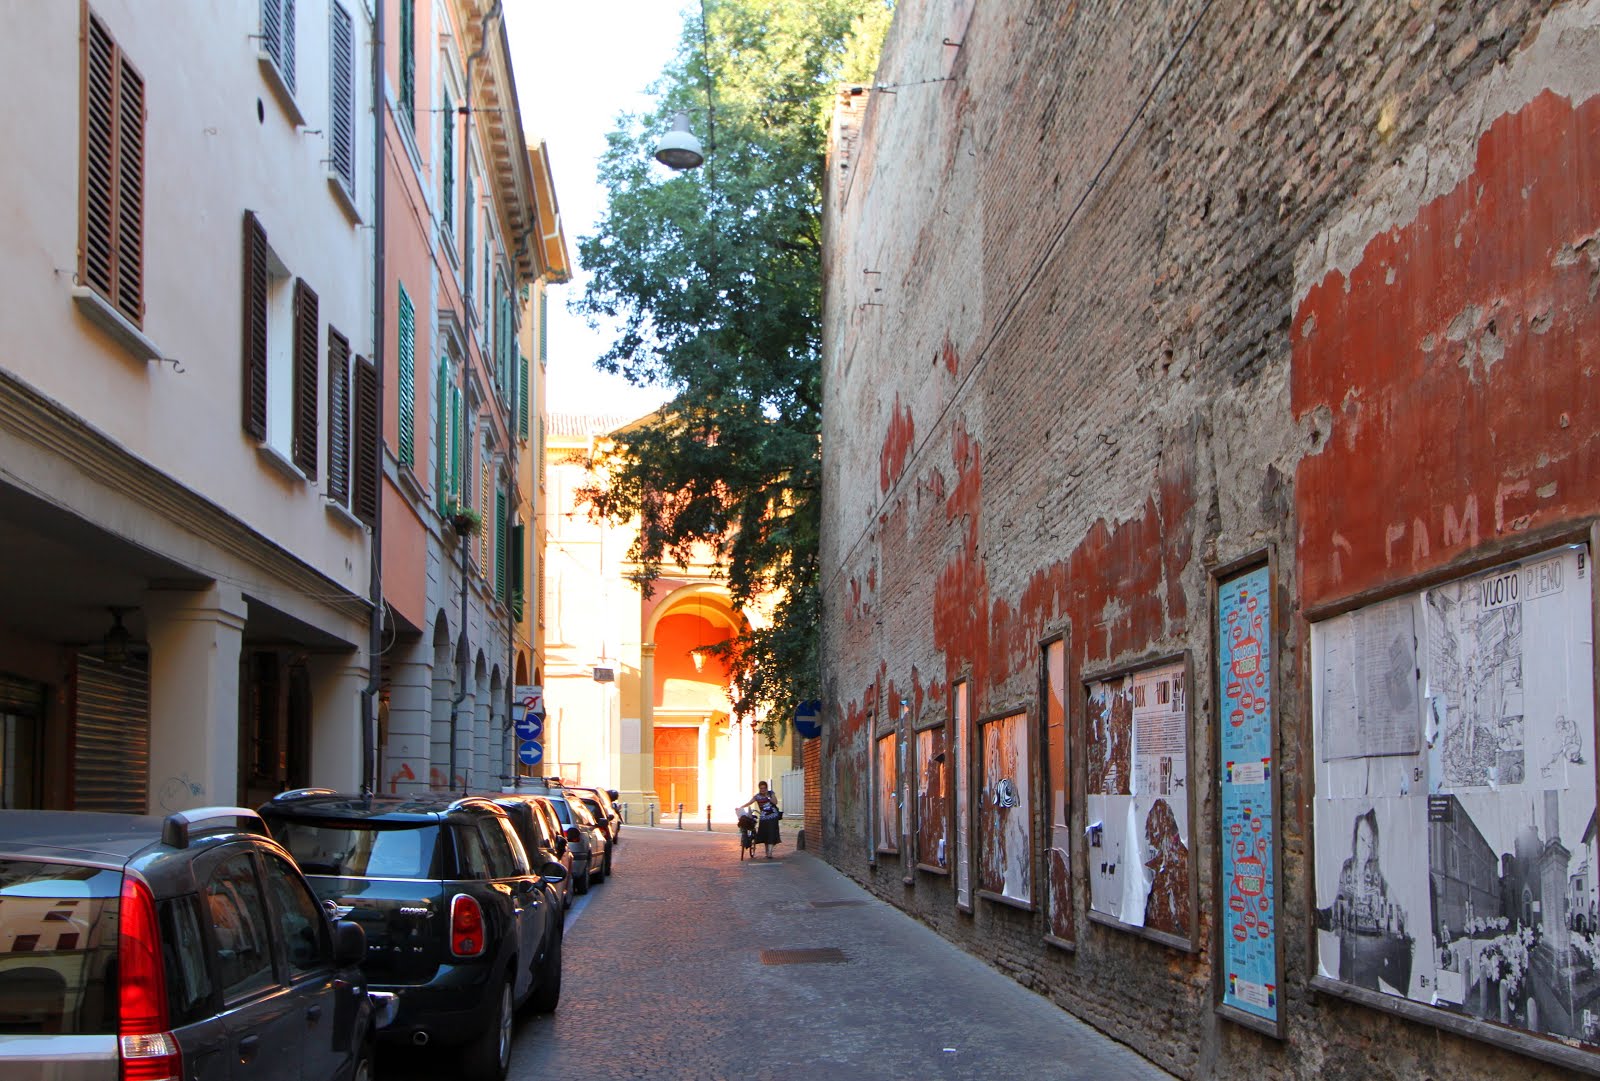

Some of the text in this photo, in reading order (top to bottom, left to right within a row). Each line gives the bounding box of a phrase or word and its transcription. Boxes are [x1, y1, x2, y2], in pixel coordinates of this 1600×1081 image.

[1526, 560, 1562, 597] PIENO
[1482, 574, 1518, 607] VUOTO
[1233, 642, 1259, 662] BOLOGNA
[1240, 657, 1257, 674] PRIDE
[1135, 685, 1146, 708] BOX
[1236, 863, 1263, 879] BOLOGNA
[1243, 876, 1261, 893] PRIDE
